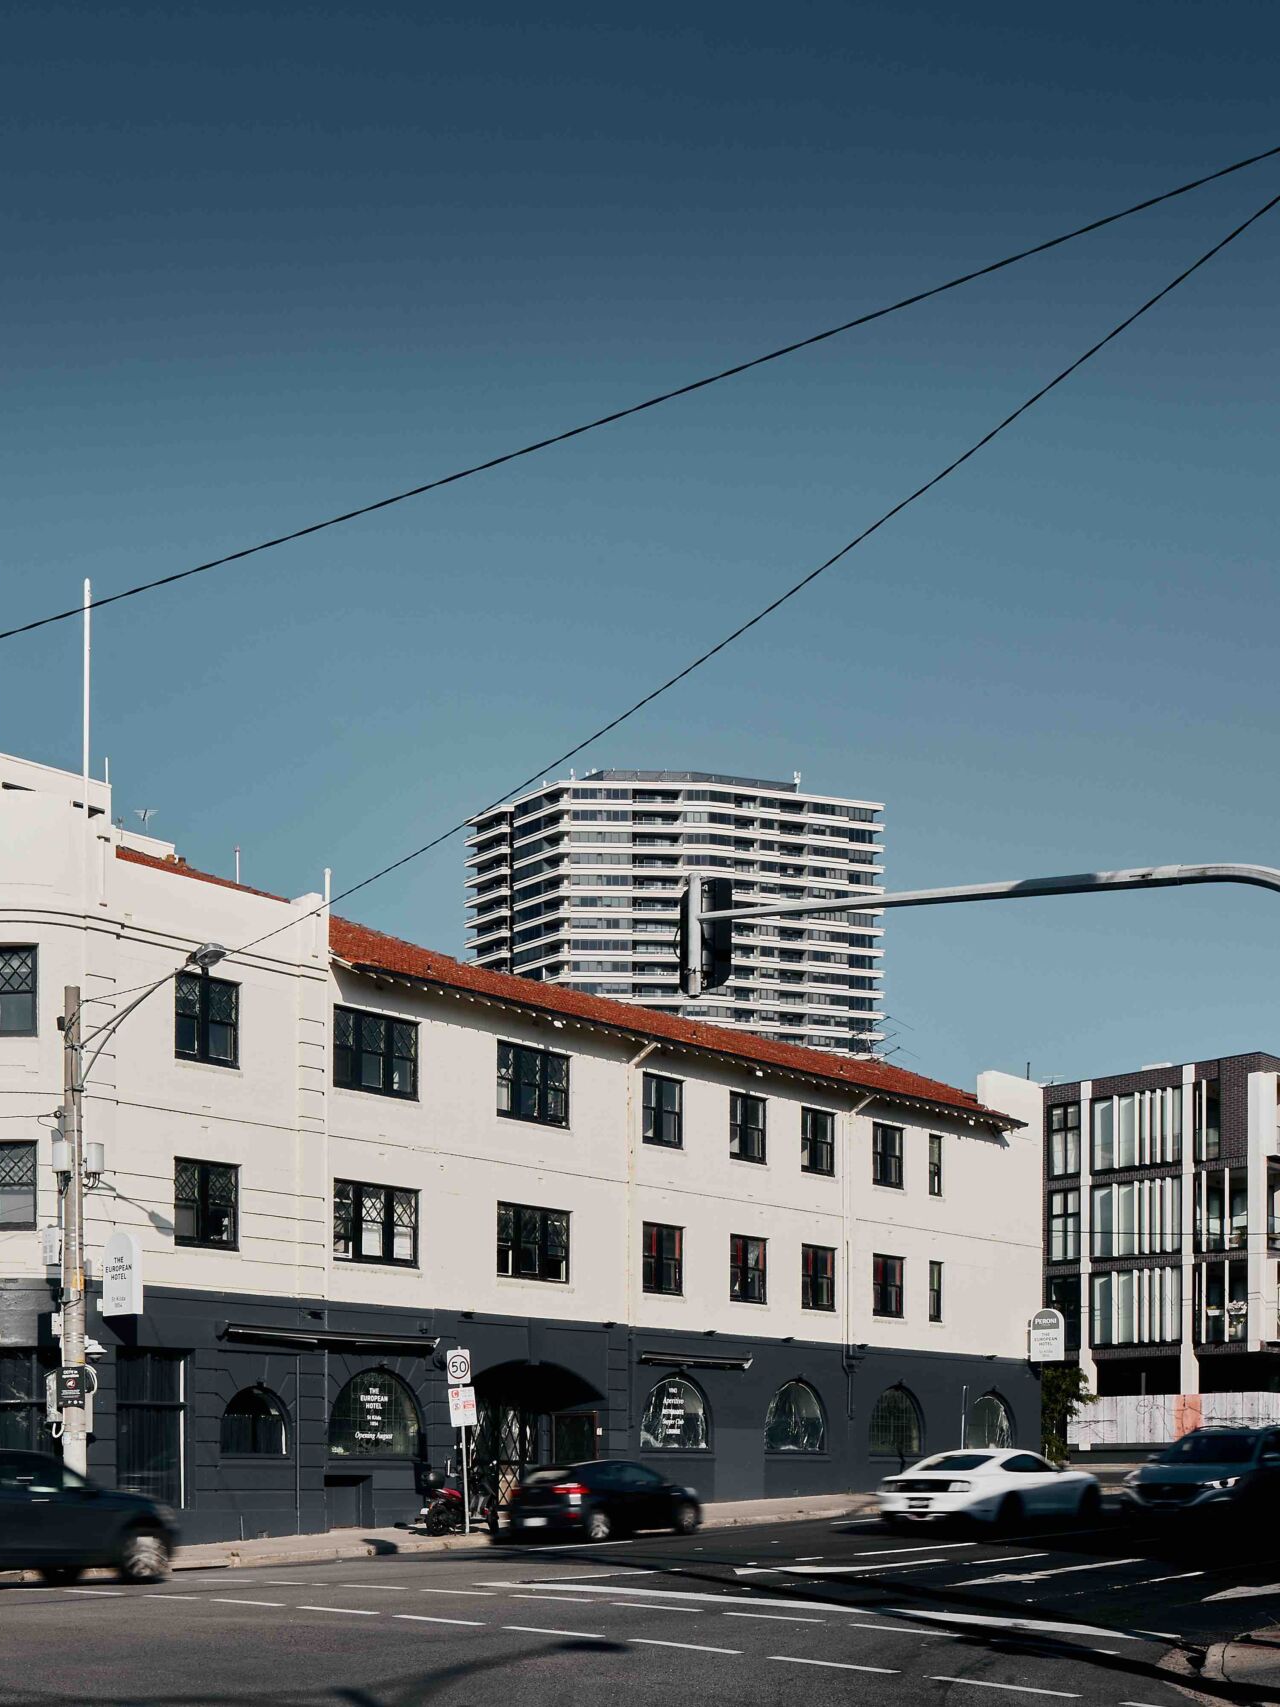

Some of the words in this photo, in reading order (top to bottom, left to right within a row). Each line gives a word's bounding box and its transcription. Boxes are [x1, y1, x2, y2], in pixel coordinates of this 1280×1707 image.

[113, 1256, 124, 1264] THE
[105, 1264, 133, 1273] EUROPEAN
[110, 1273, 127, 1281] HOTEL
[451, 1360, 467, 1374] 50
[369, 1387, 380, 1395] THE
[360, 1394, 389, 1402] EUROPEAN
[365, 1402, 383, 1410] HOTEL
[354, 1431, 376, 1440] Opening
[376, 1431, 393, 1440] August
